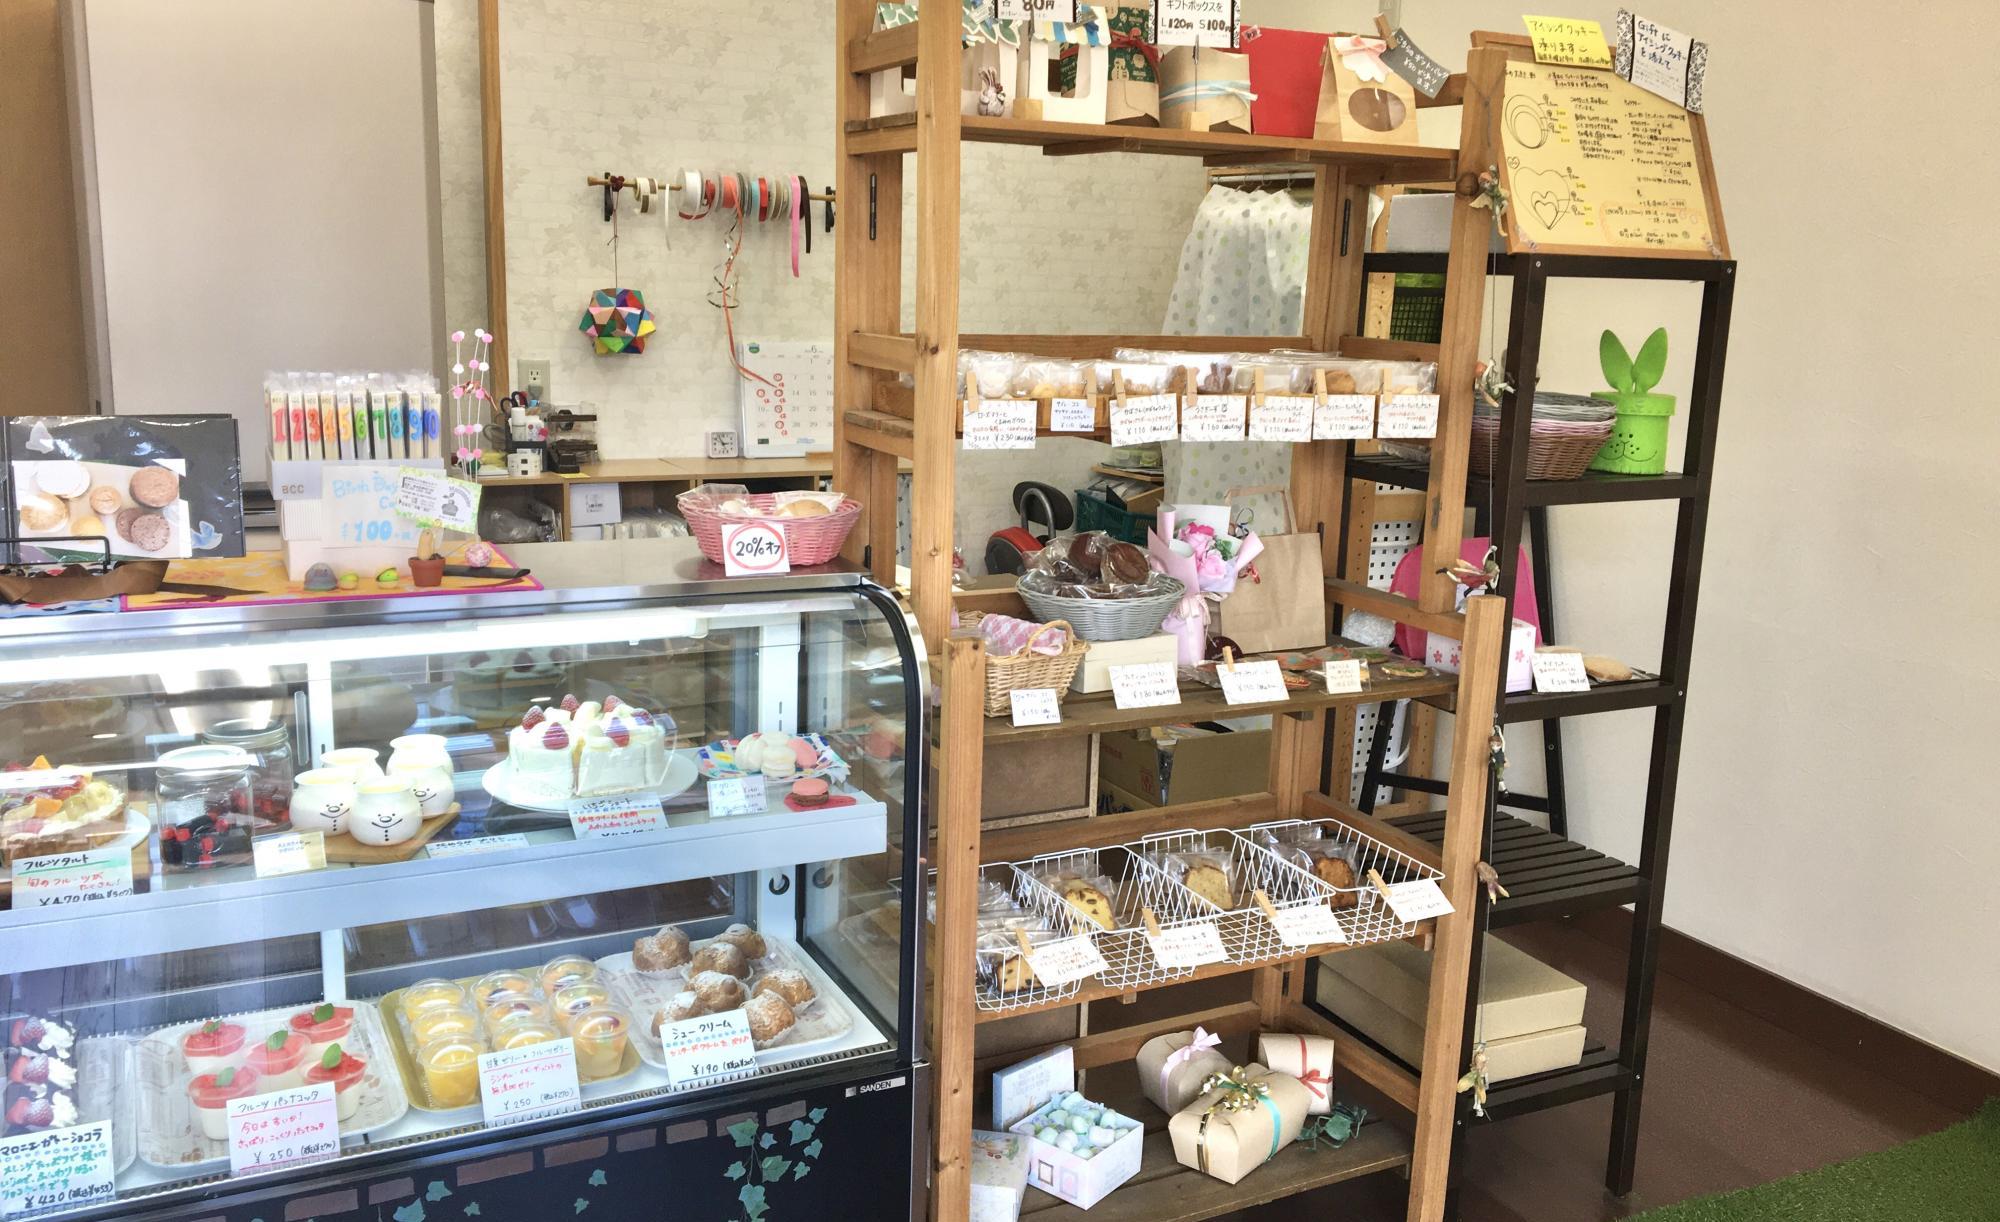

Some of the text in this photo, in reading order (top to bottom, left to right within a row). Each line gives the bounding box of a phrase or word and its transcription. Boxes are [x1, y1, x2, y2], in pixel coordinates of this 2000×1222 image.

[1637, 20, 1672, 42] Gift に
[273, 408, 286, 442] 1
[291, 408, 305, 442] 2
[308, 408, 321, 442] 3
[323, 408, 337, 442] 4
[339, 408, 351, 442] 5
[355, 410, 367, 440] 6
[373, 410, 385, 440] 7
[389, 408, 403, 440] 8
[409, 408, 422, 441] 9
[428, 408, 439, 440] 0
[281, 484, 305, 495] BCC
[691, 1063, 719, 1077] ¥190
[860, 1080, 892, 1094] SANDEN
